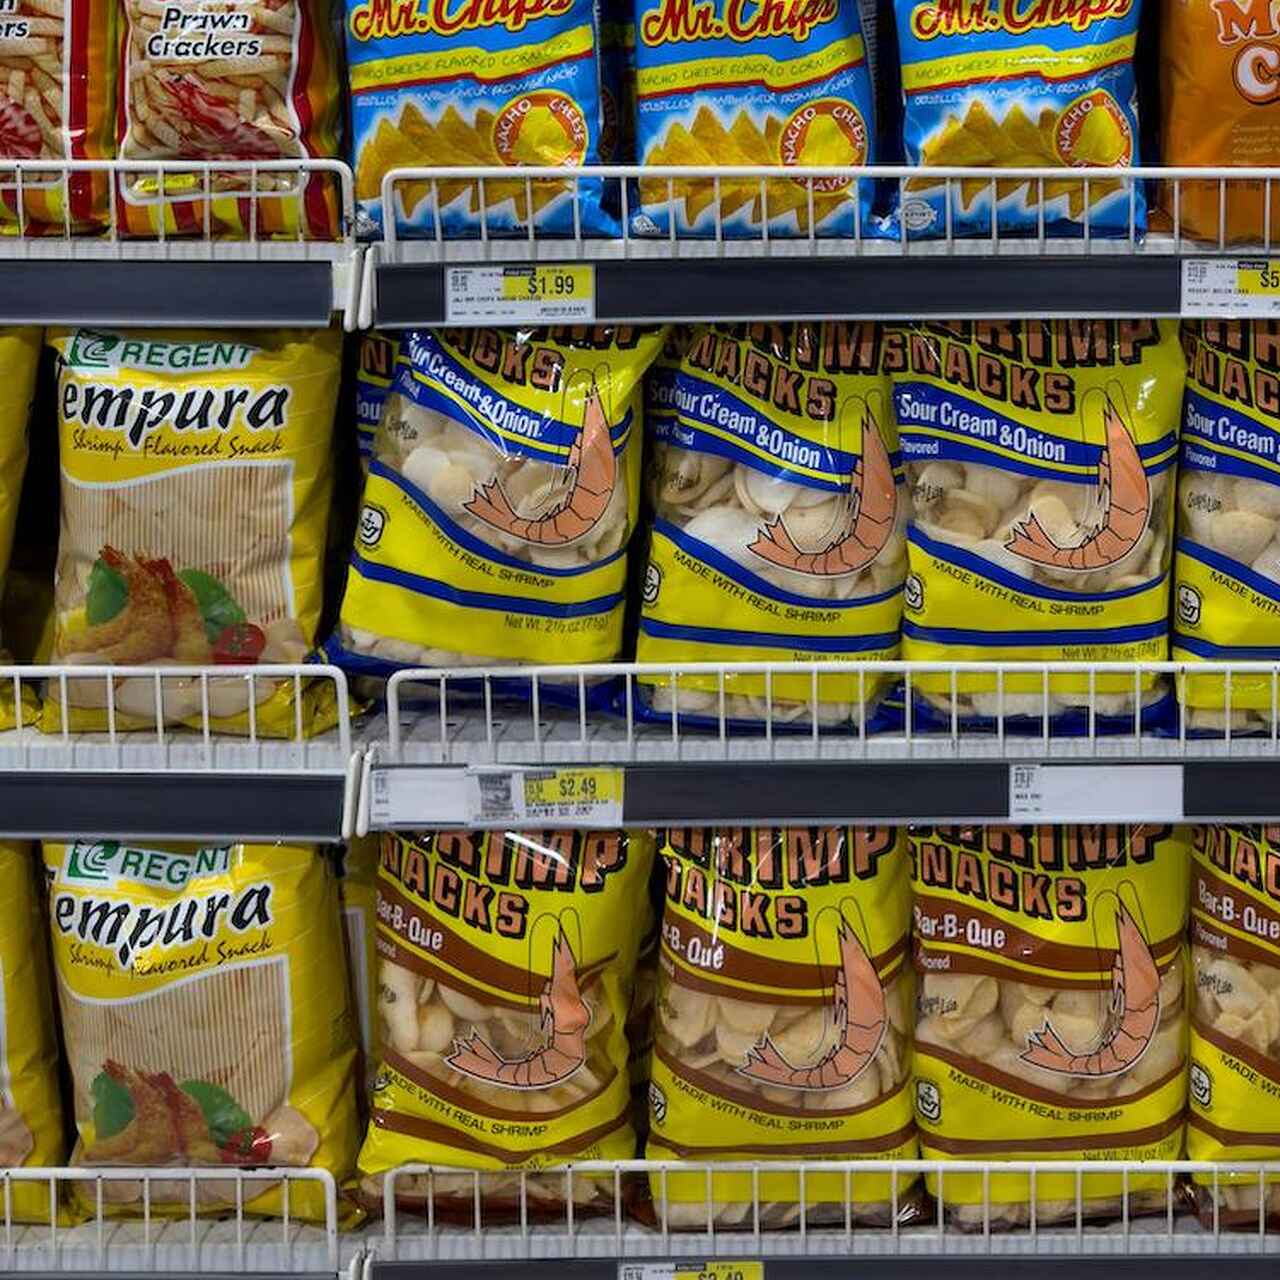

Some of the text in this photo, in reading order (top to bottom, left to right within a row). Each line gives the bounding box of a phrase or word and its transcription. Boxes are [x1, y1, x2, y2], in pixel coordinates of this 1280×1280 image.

[162, 8, 249, 30] Prawn
[147, 33, 260, 57] Crackers
[785, 107, 817, 166] NACHO
[527, 275, 575, 295] $1.99
[120, 340, 257, 369] REGENT
[885, 332, 1075, 417] SNACKS
[62, 381, 289, 447] empura
[899, 393, 938, 424] Sour
[940, 400, 998, 437] Cream
[72, 430, 283, 458] Shrimp Flavored Snack
[932, 559, 1104, 617] MADE WITH REAL SHRIMP
[558, 779, 598, 797] $2.49
[915, 906, 1006, 949] Bar-B-Que
[217, 931, 274, 966] Snack
